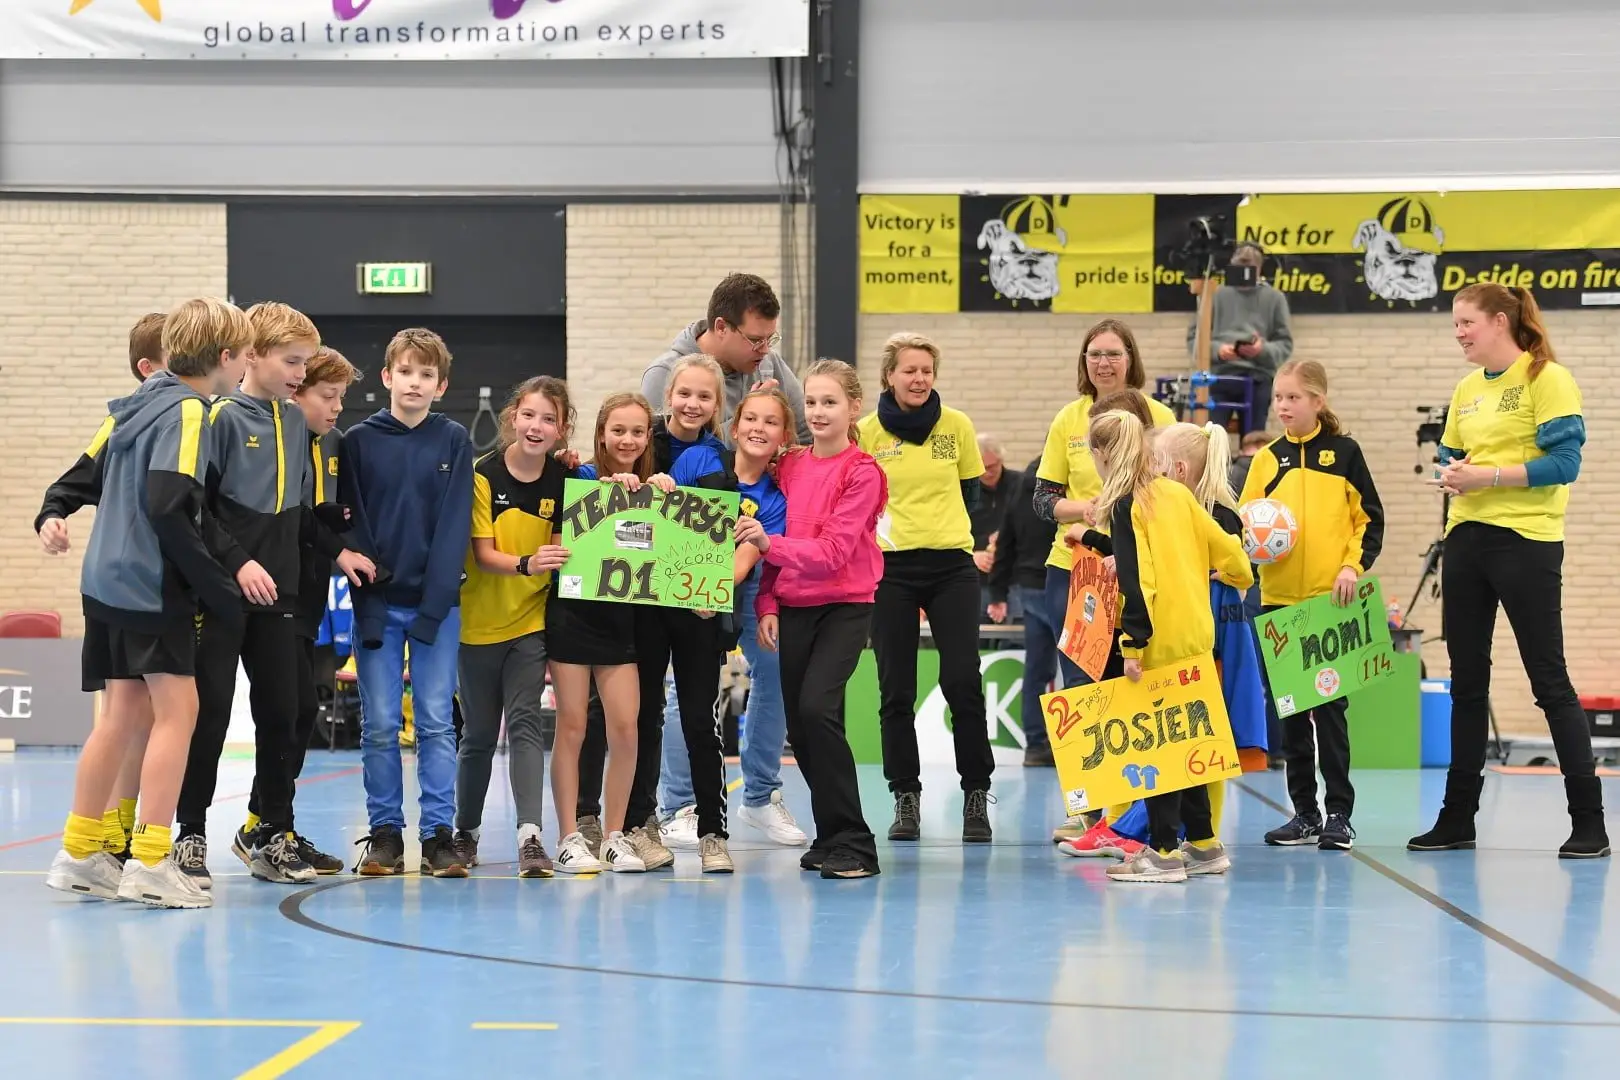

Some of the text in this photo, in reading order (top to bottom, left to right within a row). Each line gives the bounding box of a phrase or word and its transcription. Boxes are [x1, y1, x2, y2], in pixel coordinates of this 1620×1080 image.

[203, 20, 726, 48] global transformation experts
[865, 213, 955, 233] Victory is
[1245, 224, 1333, 246] Not for
[888, 241, 931, 258] for a
[865, 268, 953, 287] moment,
[1075, 265, 1129, 286] pride
[1134, 267, 1149, 284] is
[1154, 266, 1184, 285] for
[1274, 268, 1332, 295] hire,
[1442, 263, 1534, 291] D-side
[1540, 268, 1577, 289] on
[596, 556, 660, 601] D1
[664, 552, 725, 579] RECORD
[672, 572, 734, 605] 345
[1047, 695, 1082, 740] 2
[1188, 749, 1225, 775] 64
